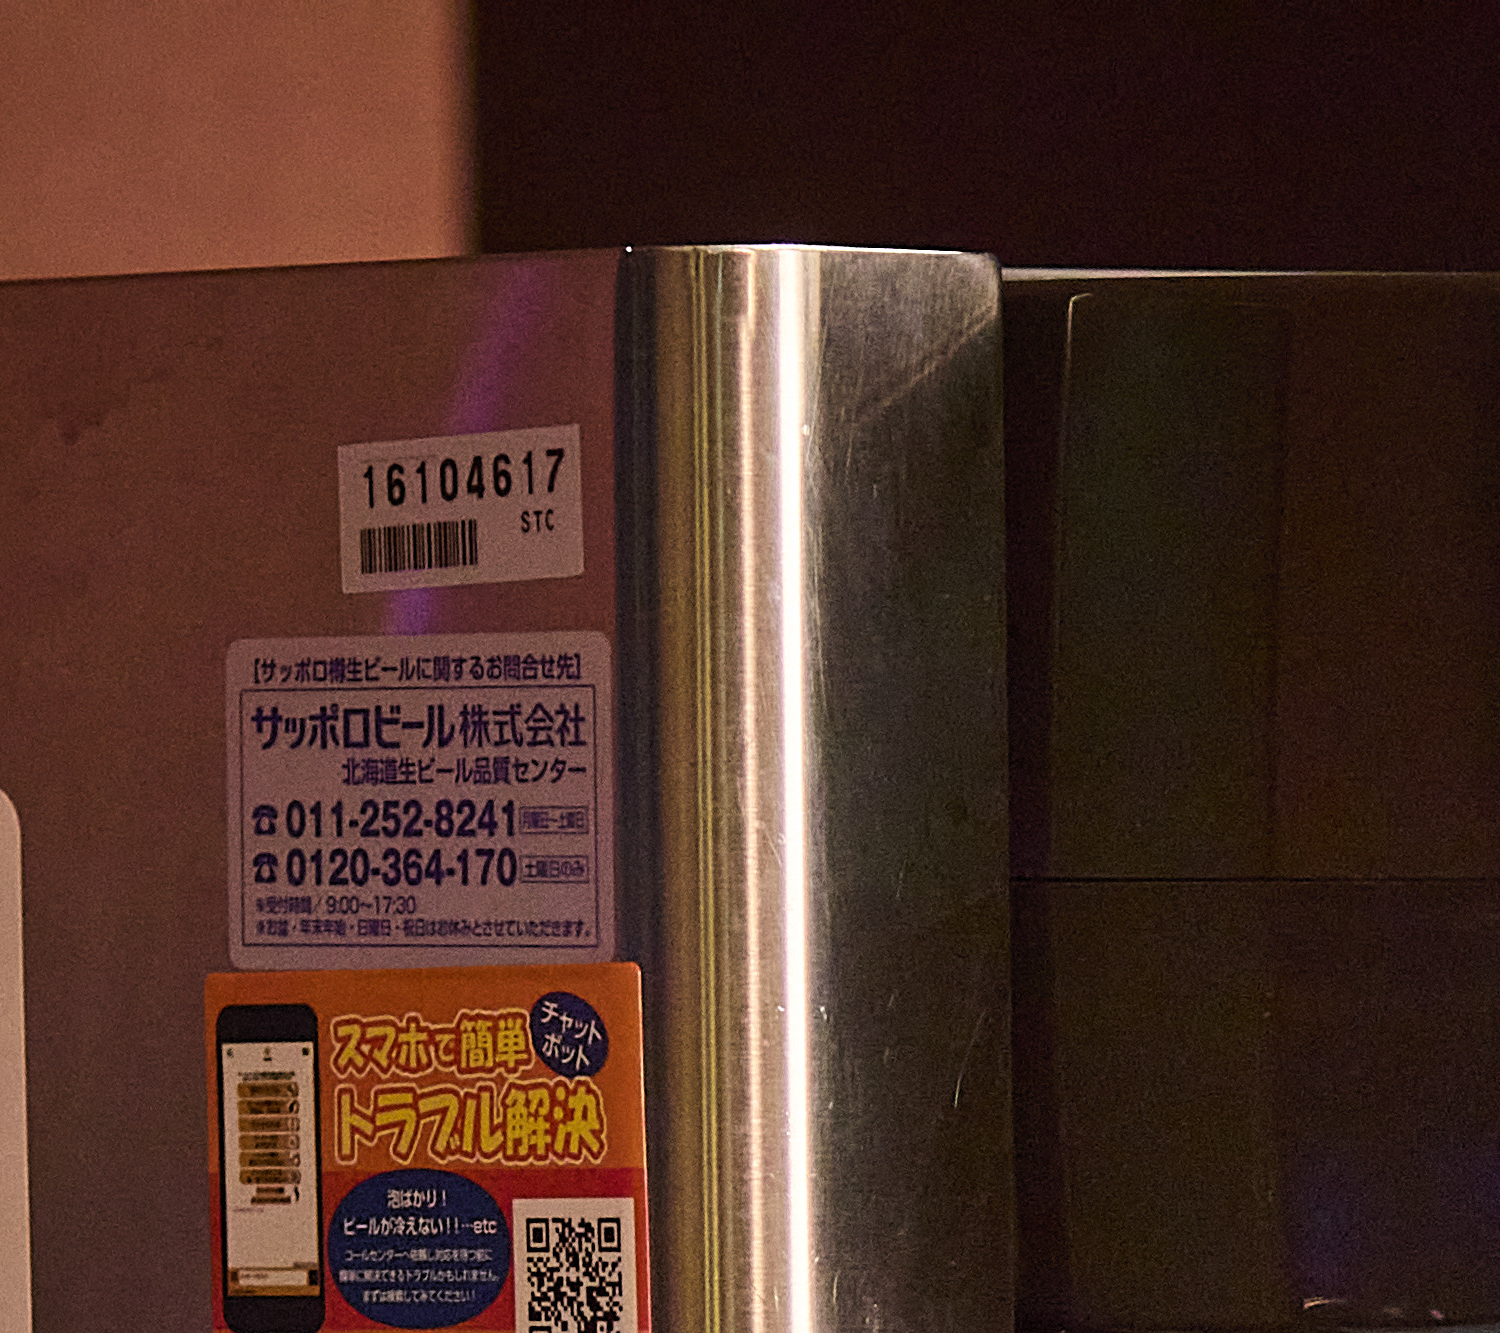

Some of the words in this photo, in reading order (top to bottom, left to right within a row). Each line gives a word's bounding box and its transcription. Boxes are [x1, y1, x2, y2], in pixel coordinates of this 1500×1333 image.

[363, 448, 566, 509] 16104617
[520, 510, 555, 533] STC
[251, 702, 587, 750] サッポロビール株式会社
[342, 756, 588, 786] 北海道生ビール品質センター
[286, 799, 516, 838] 011-252-8241
[286, 848, 518, 887] 0120-364-170
[332, 1012, 534, 1079] スマホで簡単
[540, 1000, 602, 1046] チャット
[333, 1076, 607, 1166] トラブル解決
